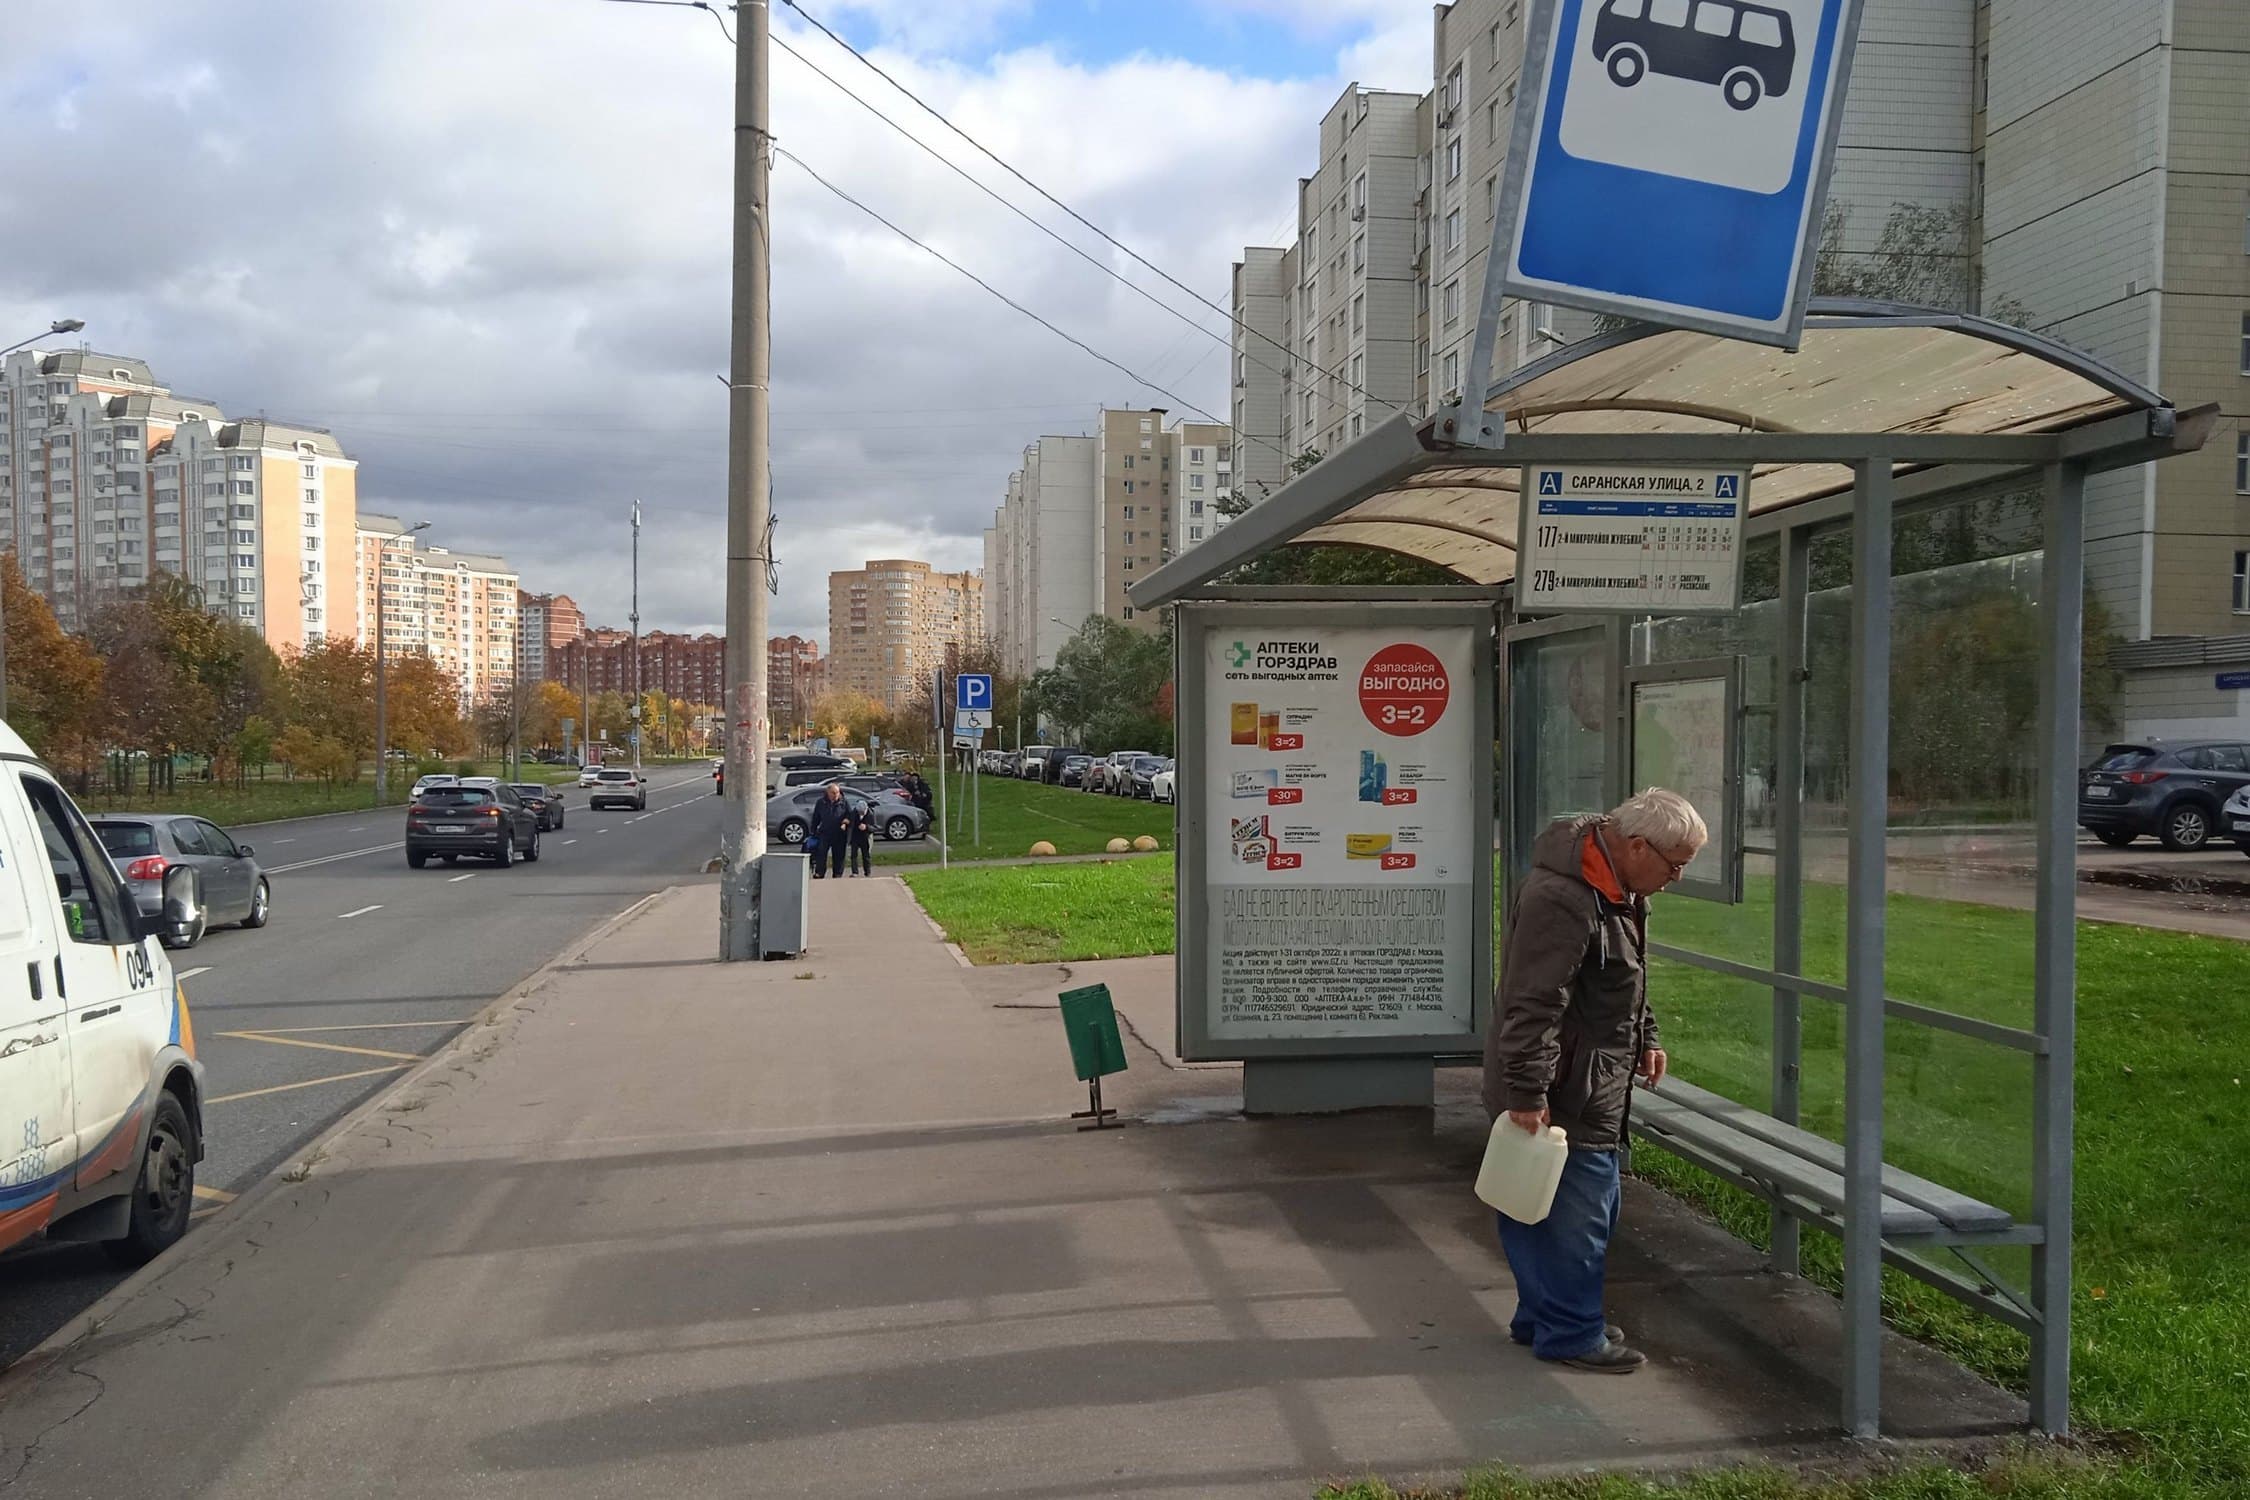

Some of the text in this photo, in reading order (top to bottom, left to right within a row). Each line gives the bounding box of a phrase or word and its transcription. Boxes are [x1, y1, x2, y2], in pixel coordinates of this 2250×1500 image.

[1572, 475, 1705, 492] САРАНСКАЯ УЛИЦА, 2
[1538, 526, 1558, 548] 177
[1534, 570, 1555, 591] 279
[1257, 642, 1319, 654] АПТЕКИ
[1257, 657, 1337, 670] ГОРЗДРАВ
[1373, 662, 1435, 672] запасайся
[1252, 673, 1306, 682] выгодных
[1308, 673, 1339, 681] аптек
[1363, 677, 1445, 692] ВЫГОДНО
[966, 679, 985, 705] P
[1381, 705, 1425, 724] 3=2
[1274, 738, 1296, 748] 3=2
[1388, 792, 1409, 801] 3=2
[1273, 856, 1294, 867] 3=2
[1387, 857, 1409, 867] 3=2
[1377, 948, 1411, 957] ГОРЗДРАВ
[127, 948, 153, 990] 094
